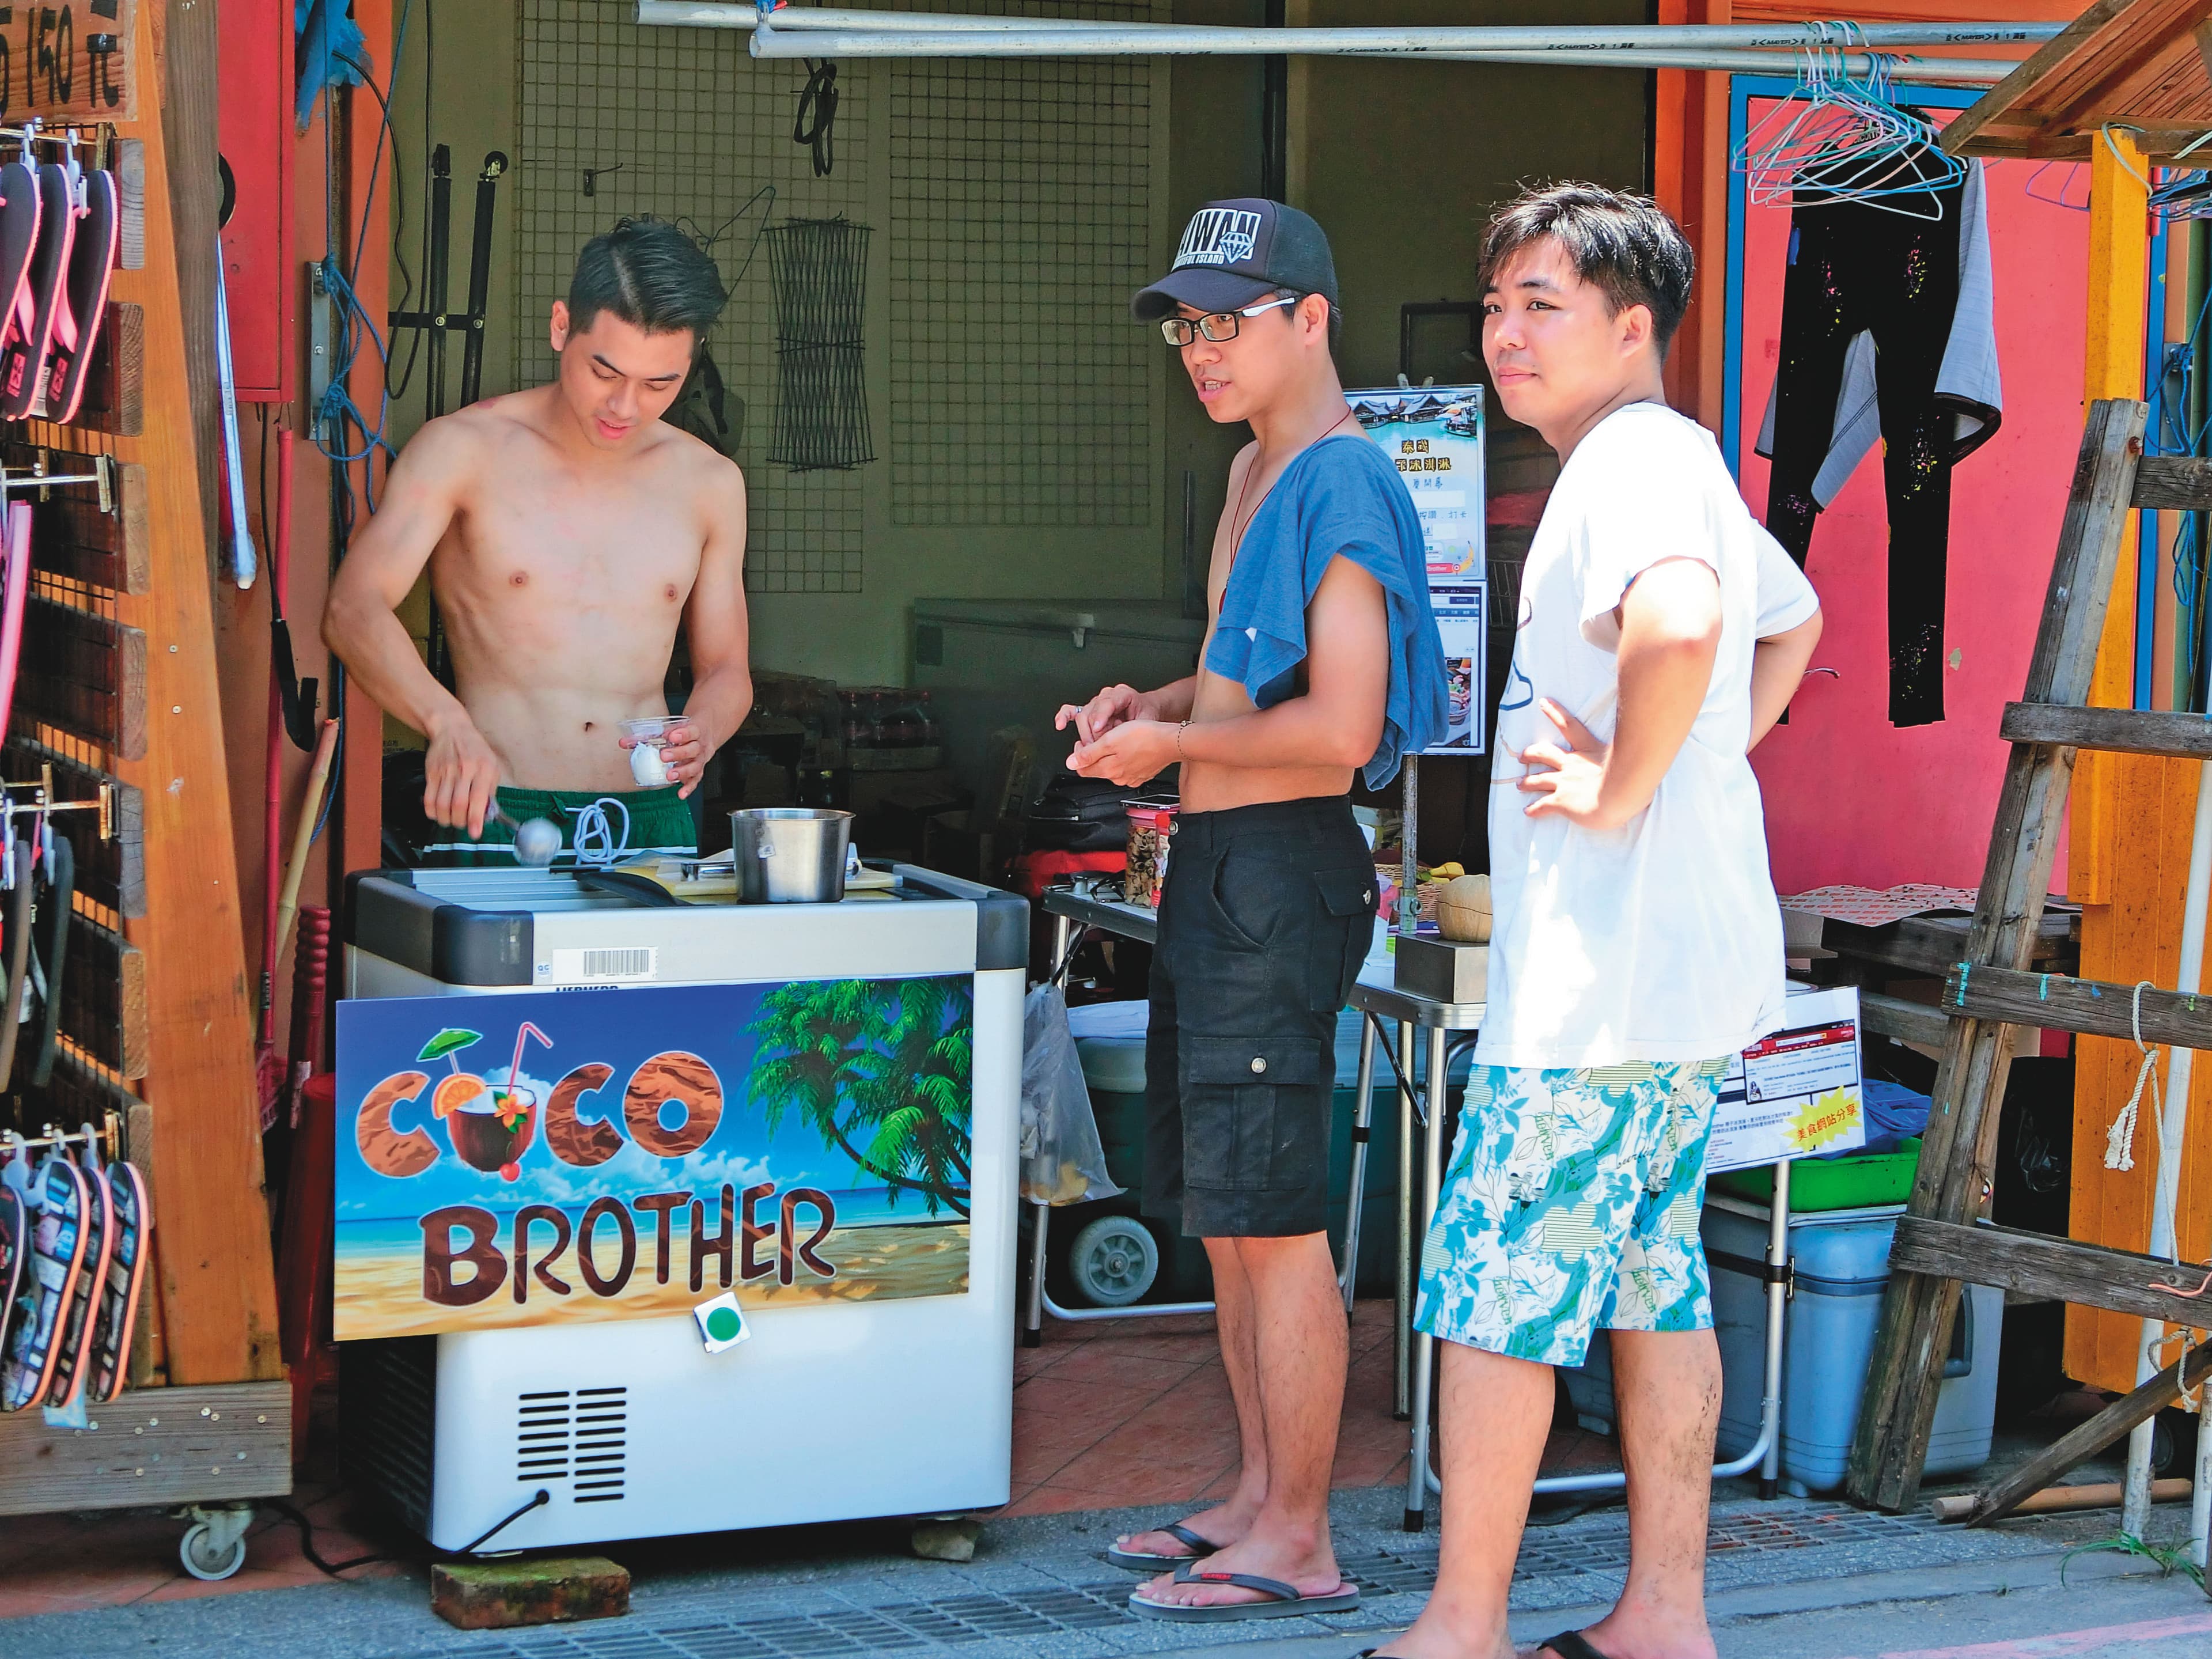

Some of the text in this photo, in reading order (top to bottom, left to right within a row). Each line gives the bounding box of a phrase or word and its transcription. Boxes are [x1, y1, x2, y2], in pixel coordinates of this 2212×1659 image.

[1797, 1103, 1857, 1142] 美食網站分享
[419, 1182, 836, 1307] BROTHER
